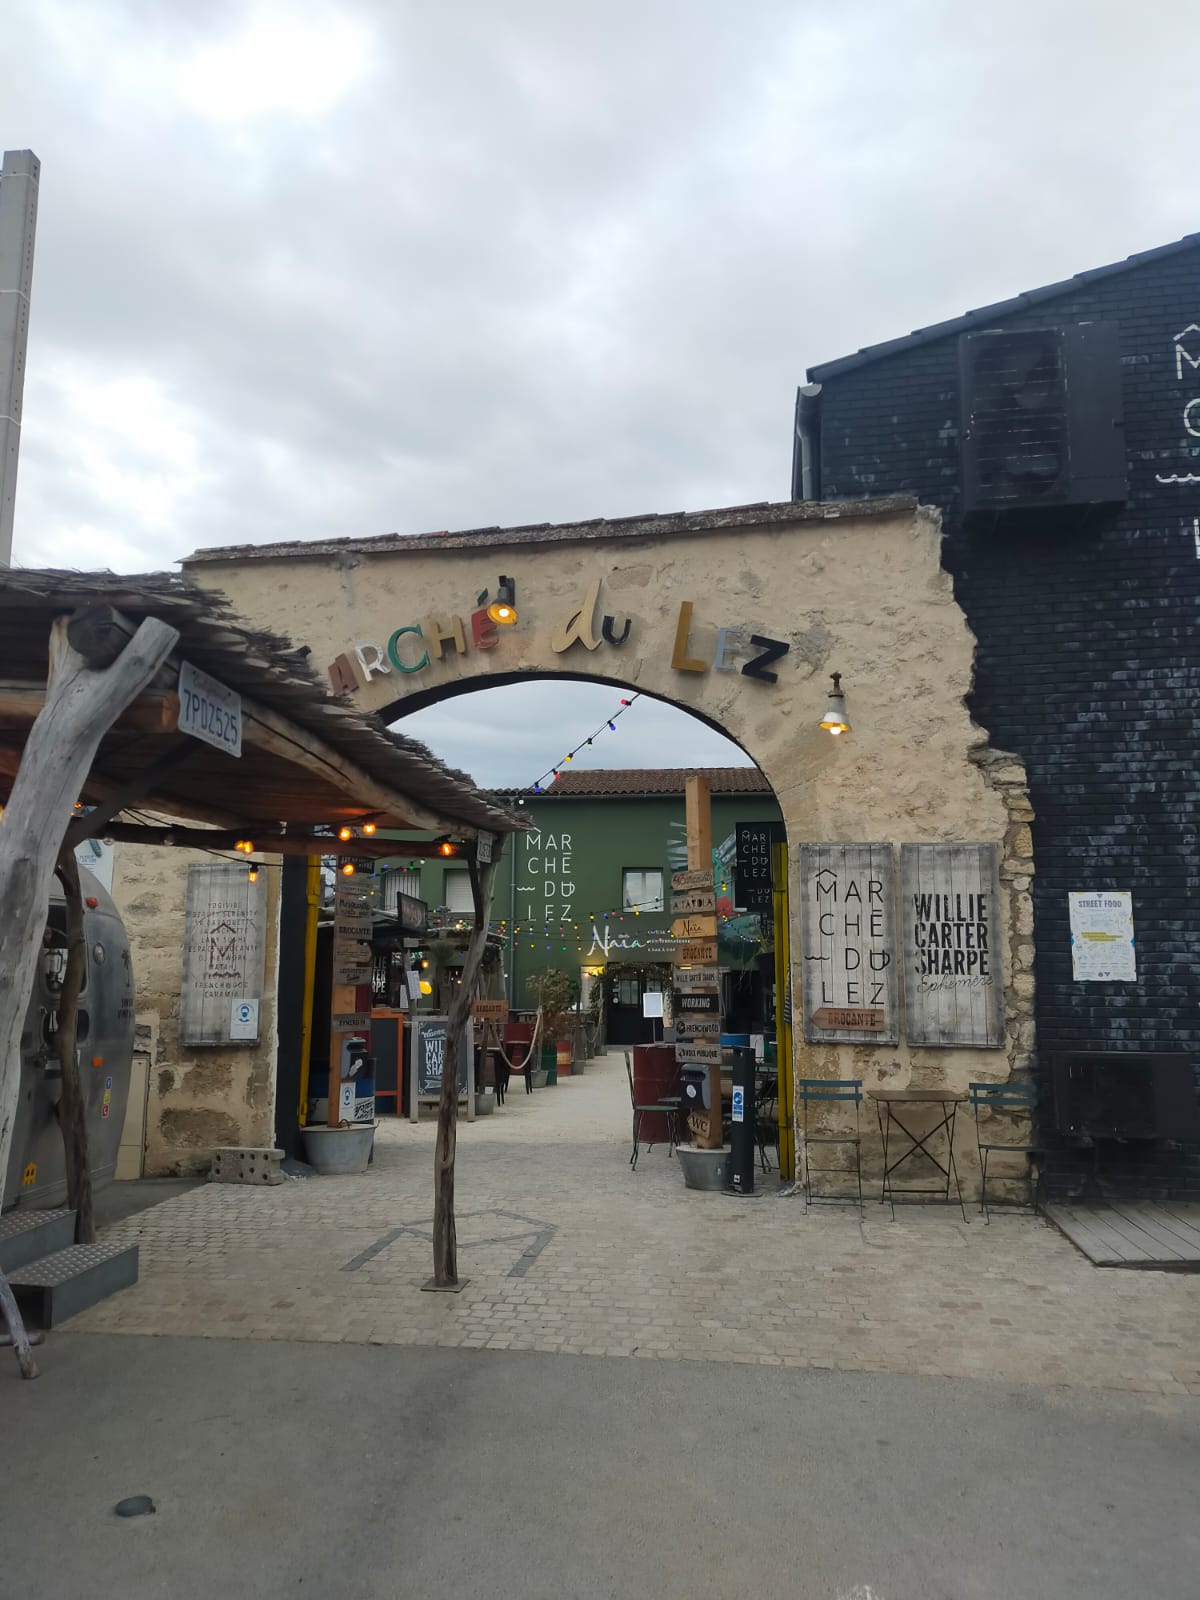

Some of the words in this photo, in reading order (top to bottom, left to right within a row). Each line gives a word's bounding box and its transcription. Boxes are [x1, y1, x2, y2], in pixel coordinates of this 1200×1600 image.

[303, 588, 501, 696] ARCHÉ
[671, 600, 790, 684] LEZ
[526, 829, 572, 851] MAR
[741, 831, 767, 843] MAR
[743, 868, 768, 878] LEZ
[815, 873, 884, 903] MAR
[527, 903, 573, 922] LEZ
[912, 893, 989, 923] WILLIE
[1078, 900, 1102, 908] STREET
[1104, 900, 1123, 908] FOOD
[914, 922, 988, 950] CARTER
[914, 949, 990, 976] SHARPE
[681, 998, 711, 1008] WORKING
[821, 981, 885, 1005] LEZ
[827, 1011, 876, 1027] BROCANTE
[692, 1116, 708, 1133] WC
